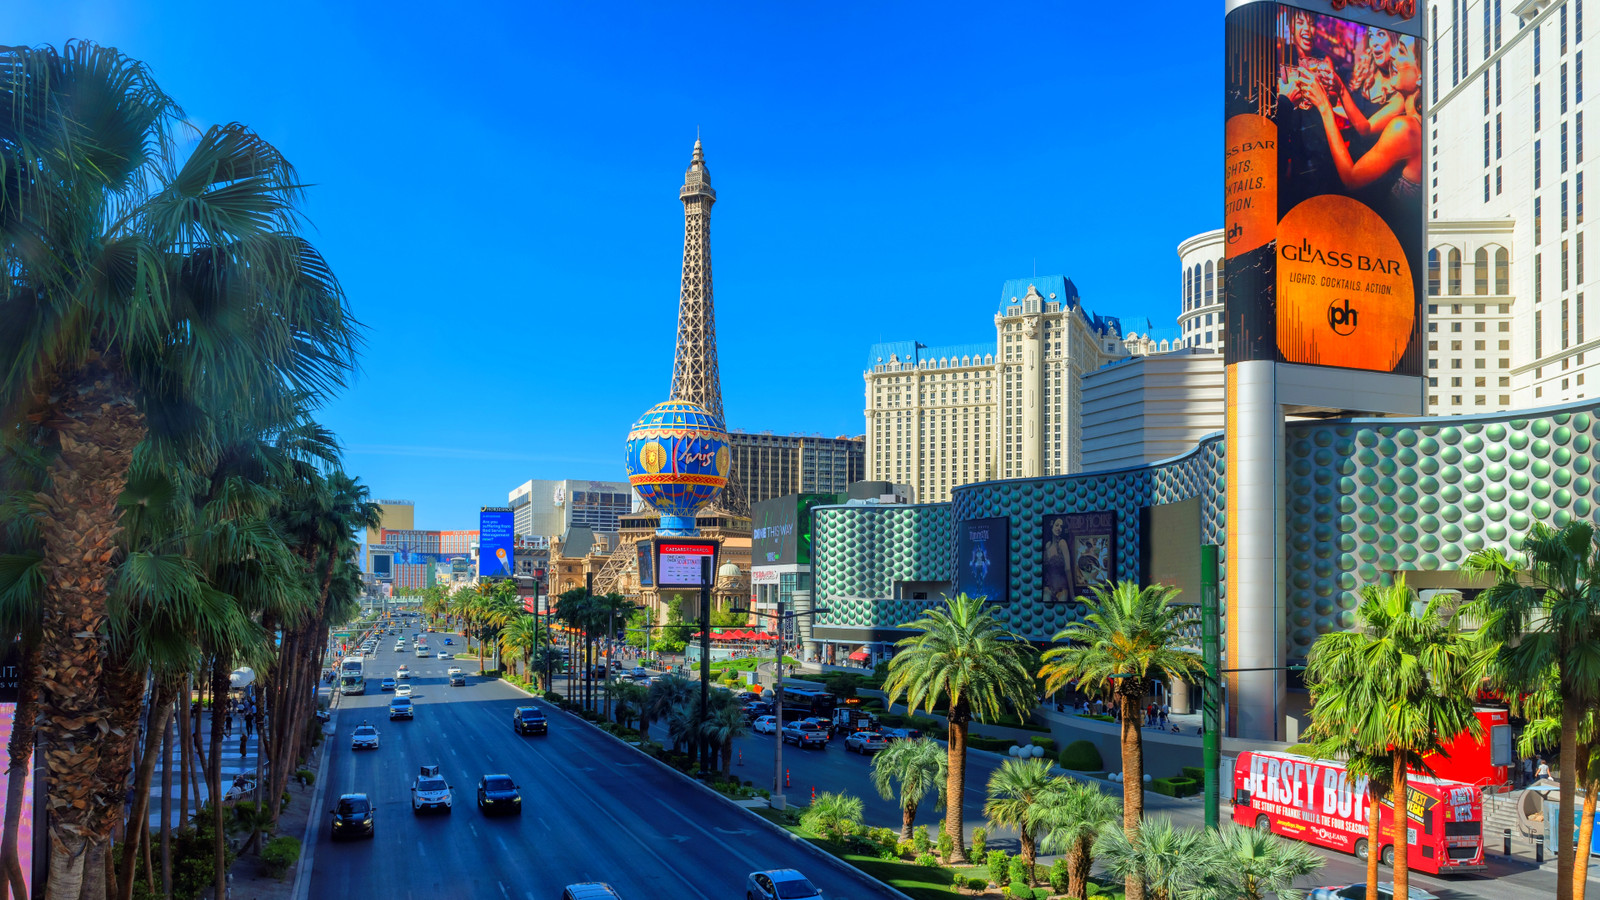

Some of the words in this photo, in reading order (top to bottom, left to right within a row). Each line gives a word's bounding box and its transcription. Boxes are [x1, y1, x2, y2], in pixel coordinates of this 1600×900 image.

[1242, 140, 1275, 152] BAR
[1281, 238, 1353, 269] GLASS
[1357, 255, 1402, 276] BAR
[1289, 272, 1318, 286] LIGHTS.
[1320, 276, 1363, 292] COCKTAILS.
[1364, 282, 1393, 296] ACTION.
[1331, 299, 1358, 331] ph
[672, 430, 715, 478] Paris
[753, 527, 767, 539] DINE
[767, 525, 780, 538] THIS
[780, 522, 794, 536] WAY
[1244, 754, 1320, 811] JERSEY
[1412, 790, 1428, 807] BEST
[1252, 799, 1261, 809] THE
[1261, 801, 1276, 814] STORY
[1275, 804, 1283, 815] OF
[1282, 805, 1302, 820] FRANKIE
[1301, 811, 1316, 823] VALLI
[1321, 815, 1331, 827] THE
[1331, 818, 1344, 830] FOUR
[1319, 828, 1349, 844] ORLEANS
